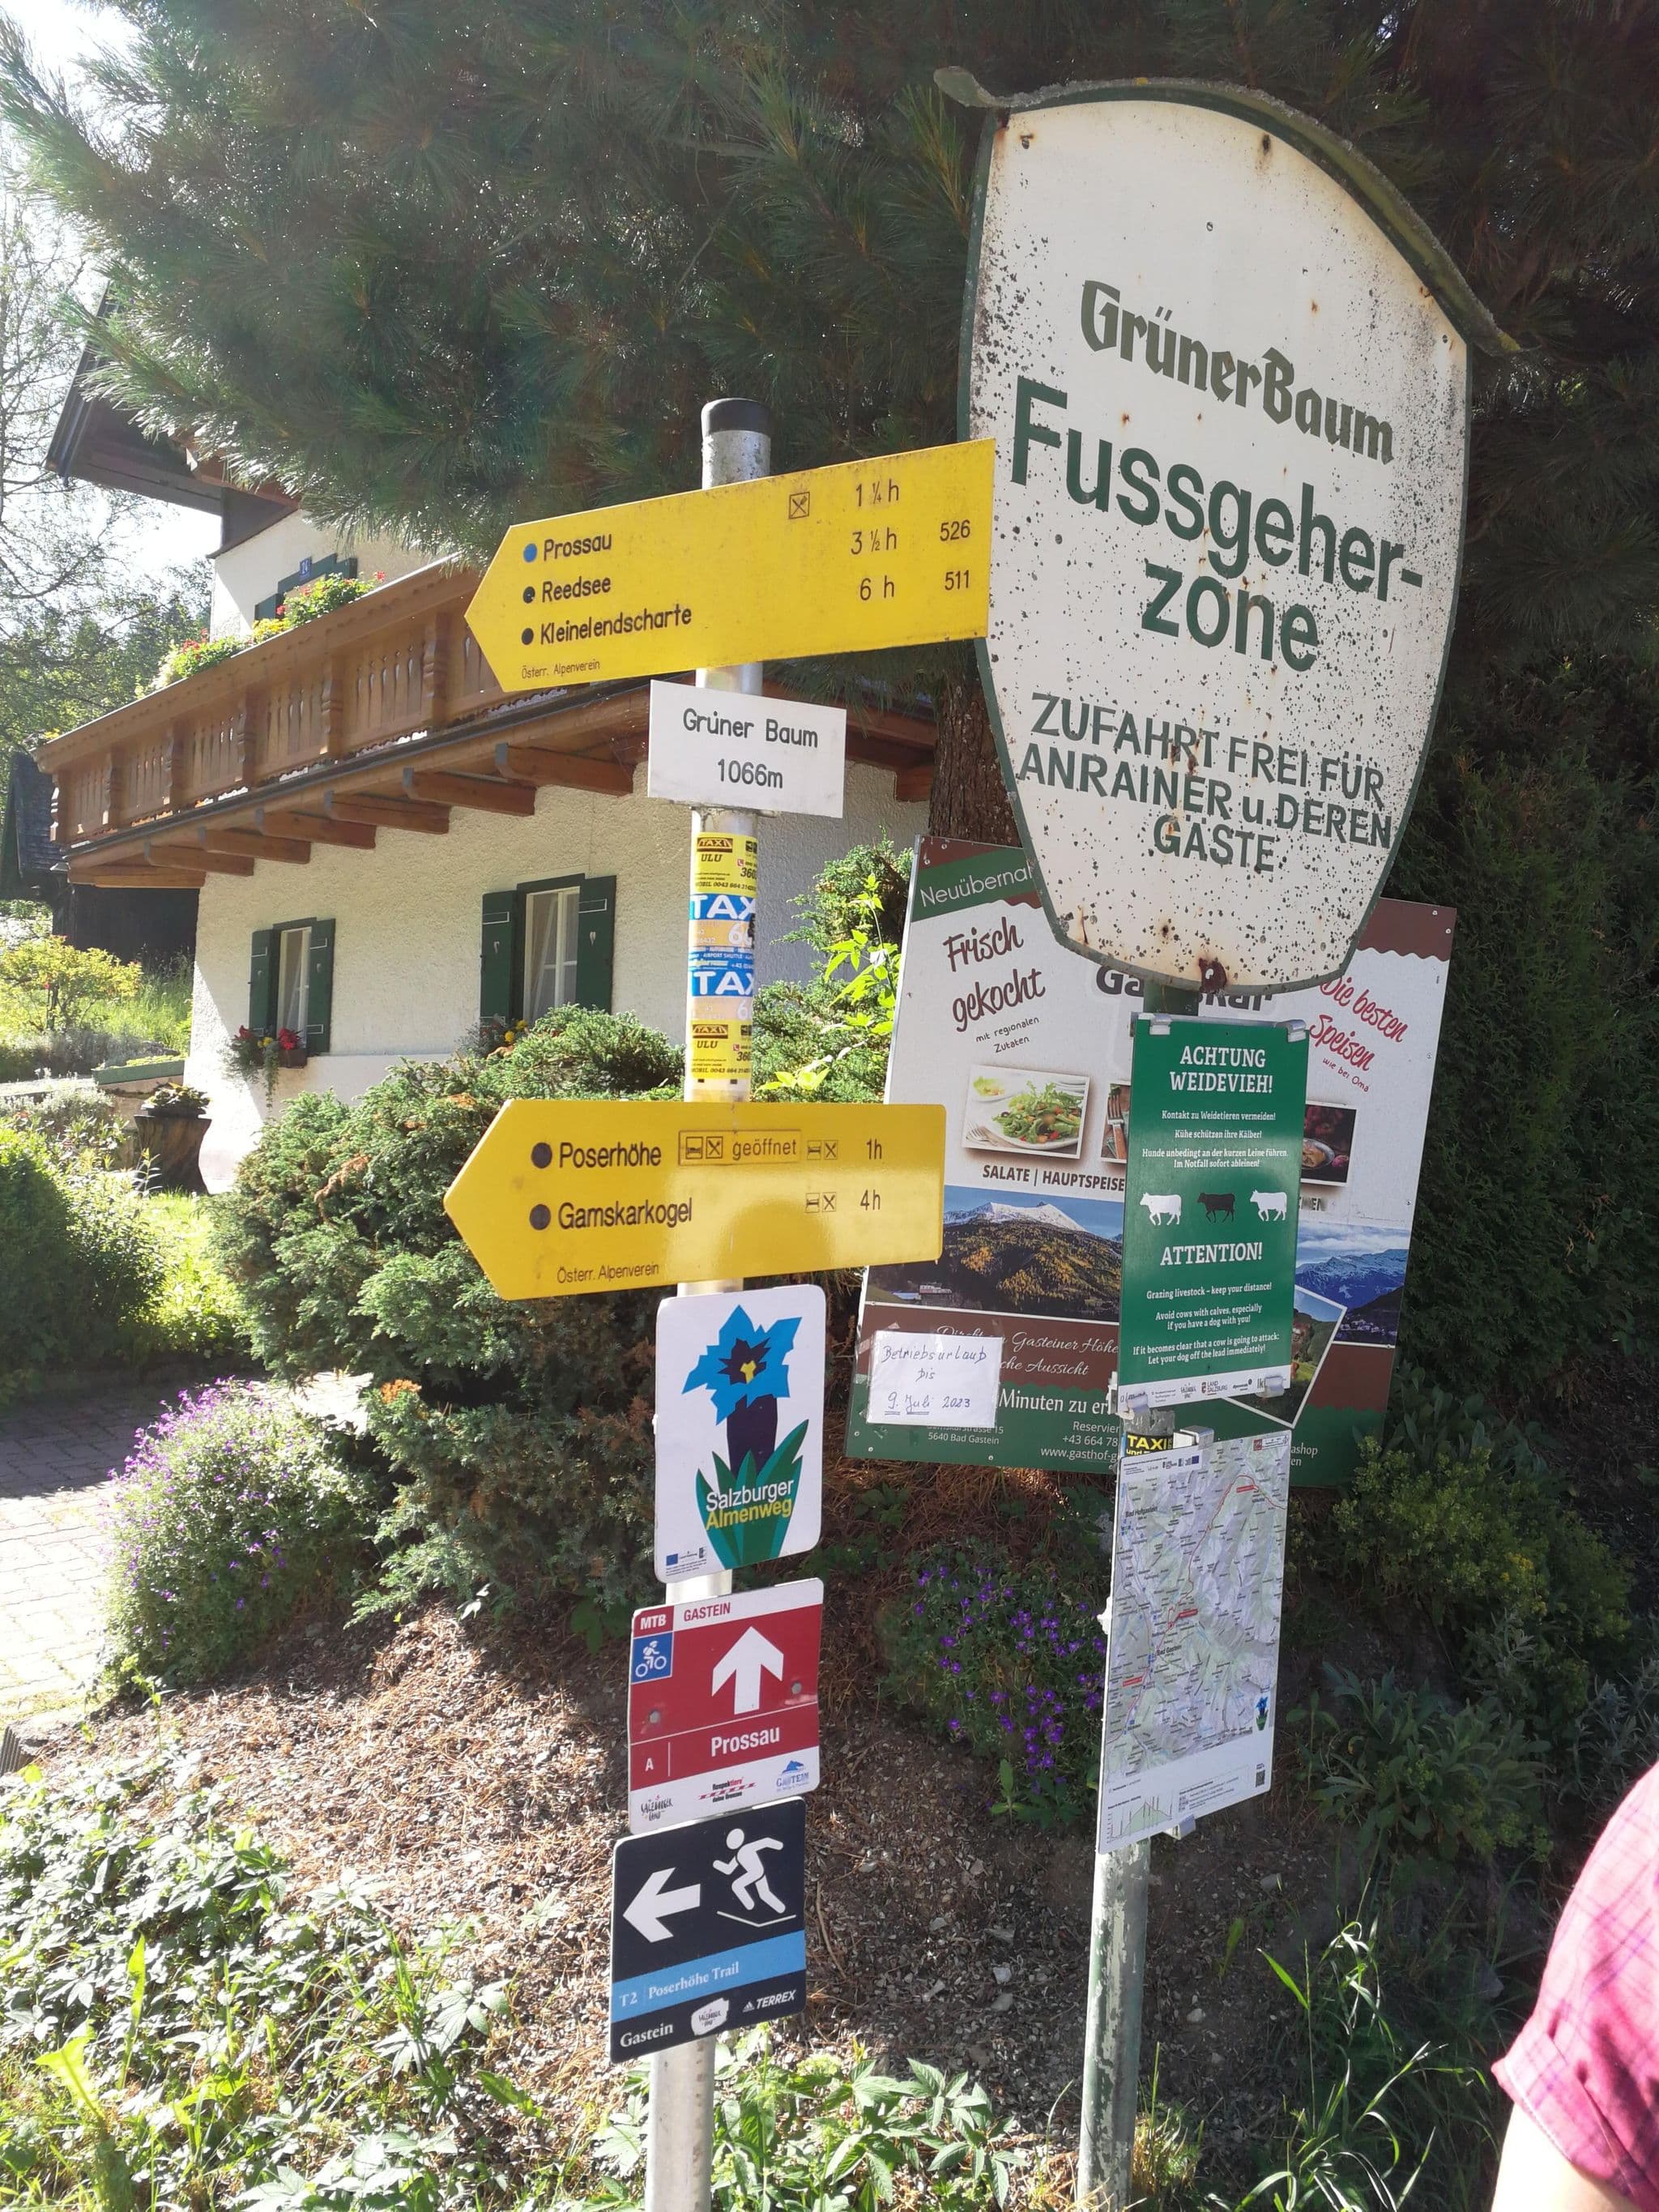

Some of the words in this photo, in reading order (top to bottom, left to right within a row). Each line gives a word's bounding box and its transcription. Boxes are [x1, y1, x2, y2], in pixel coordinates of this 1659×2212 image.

[1011, 374, 1422, 602] Fussgeher-
[939, 519, 971, 543] 526
[544, 533, 612, 562] Prossau
[541, 577, 611, 603] Reedsee
[860, 578, 872, 601] 6
[884, 575, 895, 598] h
[945, 570, 970, 591] 511
[540, 606, 692, 645] Kleinelendscharte
[1141, 559, 1319, 672] zone
[521, 665, 549, 680] Österr.
[553, 660, 600, 677] Alpenverein
[683, 707, 754, 738] Grüner
[766, 719, 818, 748] Baum
[1030, 693, 1219, 767] ZUFAHRT
[1229, 737, 1307, 788] FREI
[1320, 751, 1384, 808] FÜR
[718, 758, 783, 788] 1066m
[1017, 743, 1233, 820] ANRAINER
[1154, 814, 1275, 873] GÄSTE
[701, 854, 723, 862] ULU
[691, 895, 756, 920] TAX
[943, 916, 1024, 971] Frisch
[693, 971, 753, 995] TAX
[953, 968, 1045, 1032] gekocht
[1320, 976, 1354, 1006] Die
[1353, 989, 1408, 1042] besten
[975, 1032, 990, 1042] mit
[995, 1016, 1039, 1037] regionalen
[697, 1040, 718, 1048] ULU
[994, 1036, 1030, 1053] Zutaten
[1309, 1014, 1375, 1071] Speisen
[1179, 1045, 1266, 1068] ACHTUNG
[1170, 1071, 1273, 1093] WEIDEVIEH!
[1323, 1057, 1336, 1070] wie
[1338, 1067, 1350, 1078] bei
[1352, 1076, 1369, 1092] Oma
[1162, 1110, 1189, 1119] Kontakt
[1192, 1112, 1199, 1120] zu
[1201, 1111, 1239, 1120] Weidetieren
[1241, 1112, 1276, 1121] vermeiden!
[1175, 1129, 1192, 1138] Kühe
[1194, 1129, 1223, 1138] schützen
[1224, 1129, 1238, 1138] ihre
[1239, 1129, 1261, 1138] Kälber!
[559, 1142, 661, 1168] Poserhöhe
[732, 1139, 797, 1161] geöffnet
[1142, 1149, 1165, 1157] Hunde
[1166, 1148, 1201, 1159] unbedingt
[1212, 1149, 1222, 1157] der
[1224, 1149, 1246, 1157] kurzen
[1174, 1159, 1183, 1168] Im
[1184, 1159, 1208, 1168] Notfall
[1209, 1159, 1229, 1168] sofort
[1231, 1159, 1260, 1168] ableinen!
[983, 1164, 1030, 1182] SALATE
[1043, 1171, 1125, 1191] HAUPTSPEISE
[558, 1198, 692, 1229] Gamskarkogel
[1160, 1242, 1263, 1266] ATTENTION!
[557, 1266, 595, 1283] Österr.
[599, 1263, 659, 1280] Alpenverein
[1146, 1290, 1174, 1300] Grazing
[1175, 1287, 1205, 1296] livestock
[1211, 1286, 1226, 1296] keep
[1227, 1286, 1243, 1295] your
[1243, 1283, 1272, 1292] distance!
[1155, 1311, 1175, 1321] Avoid
[1194, 1309, 1209, 1317] with
[1232, 1303, 1262, 1314] especially
[1167, 1322, 1174, 1330] if
[1175, 1322, 1187, 1331] you
[1188, 1320, 1203, 1328] have
[1209, 1317, 1220, 1327] dog
[1222, 1317, 1236, 1325] with
[1238, 1315, 1251, 1324] you!
[1012, 1332, 1078, 1352] Gasteiner
[1133, 1346, 1139, 1355] If
[1141, 1346, 1145, 1355] it
[1147, 1343, 1175, 1354] becomes
[1176, 1342, 1192, 1351] clear
[1193, 1340, 1207, 1349] that
[1227, 1337, 1232, 1345] is
[1234, 1336, 1250, 1347] going
[1259, 1333, 1279, 1342] attack:
[1149, 1356, 1158, 1364] Let
[1161, 1356, 1175, 1365] your
[1177, 1352, 1188, 1362] dog
[1190, 1351, 1200, 1360] off
[1201, 1350, 1211, 1358] the
[1213, 1347, 1226, 1357] lead
[1226, 1344, 1265, 1356] immediately!
[1026, 1361, 1090, 1375] Aussicht
[942, 1396, 970, 1408] 2023
[999, 1387, 1064, 1412] Minuten
[1068, 1400, 1086, 1413] zu
[928, 1433, 949, 1441] 5640
[951, 1434, 966, 1442] Bad
[969, 1435, 999, 1445] Gastein
[1073, 1421, 1120, 1433] Reservier
[1063, 1435, 1081, 1444] +43
[1084, 1436, 1102, 1445] 664
[1107, 1437, 1118, 1446] 78
[1128, 1435, 1166, 1450] TAXI
[1291, 1442, 1318, 1458] ashop
[1041, 1448, 1117, 1463] www.gasthof-g
[706, 1480, 794, 1511] Salzburger
[706, 1498, 791, 1531] Almenweg
[640, 1613, 666, 1630] MTB
[684, 1602, 731, 1621] GASTEIN
[711, 1727, 780, 1757] Prossau
[645, 1757, 654, 1771] A
[620, 1992, 638, 2007] T2
[648, 1972, 709, 1999] Poserhöhe
[711, 1962, 740, 1981] Trail
[756, 1989, 796, 2009] TERREX
[620, 2022, 673, 2048] Gastein
